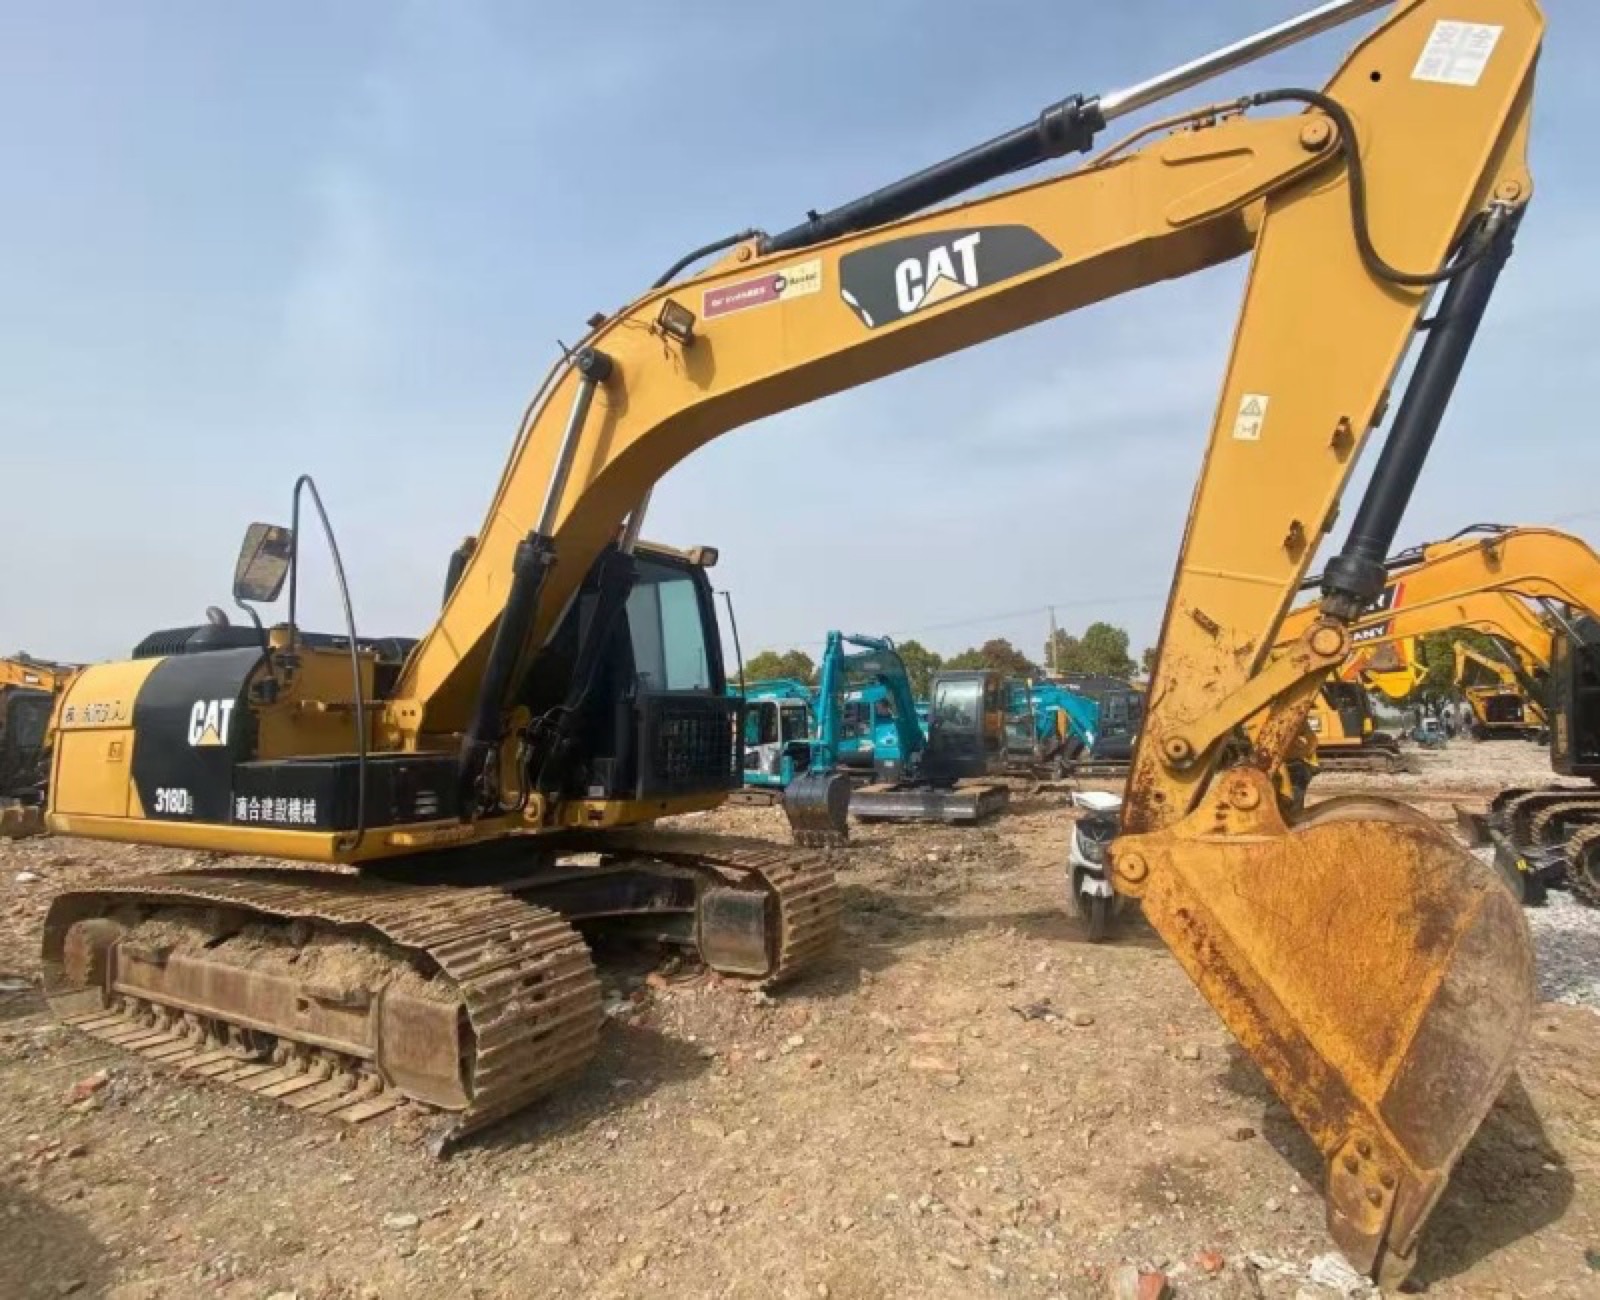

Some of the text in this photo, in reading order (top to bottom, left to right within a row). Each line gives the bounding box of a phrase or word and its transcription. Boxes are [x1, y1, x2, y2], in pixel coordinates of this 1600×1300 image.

[895, 231, 981, 313] CAT
[1353, 626, 1385, 641] ANY
[188, 698, 235, 747] CAT
